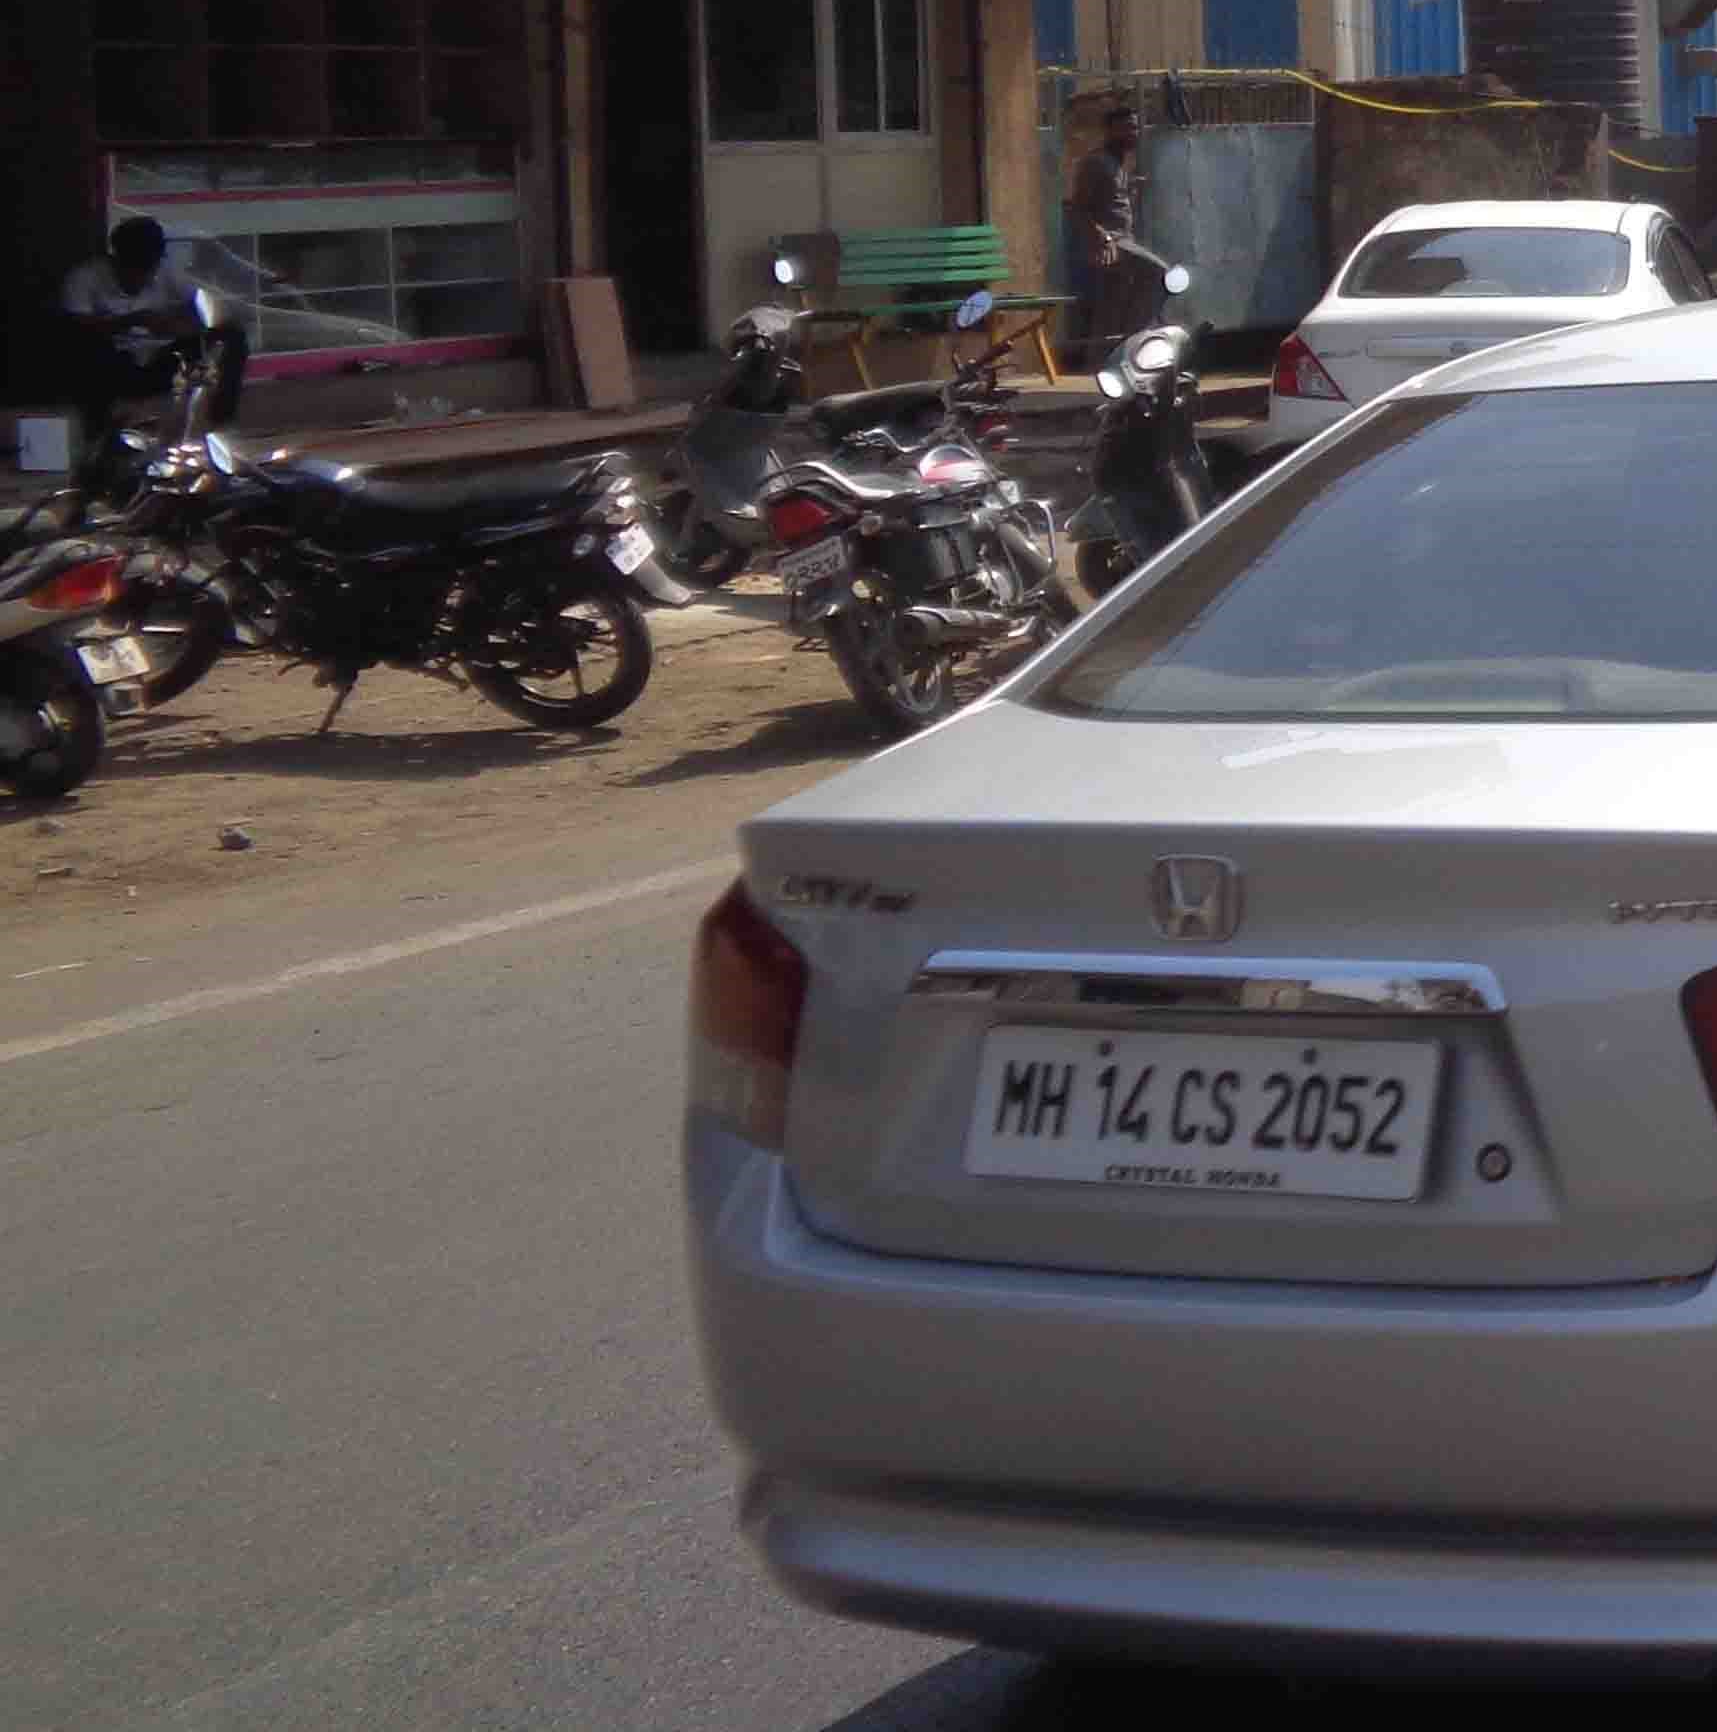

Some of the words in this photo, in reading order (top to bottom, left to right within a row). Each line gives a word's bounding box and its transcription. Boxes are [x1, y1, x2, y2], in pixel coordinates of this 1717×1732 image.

[993, 1060, 1077, 1139] MH
[1097, 1065, 1157, 1142] 14
[1171, 1069, 1242, 1147] CS
[1251, 1073, 1407, 1156] 2052
[1105, 1164, 1197, 1185] CRYSTAL
[1206, 1169, 1281, 1188] HONDA
